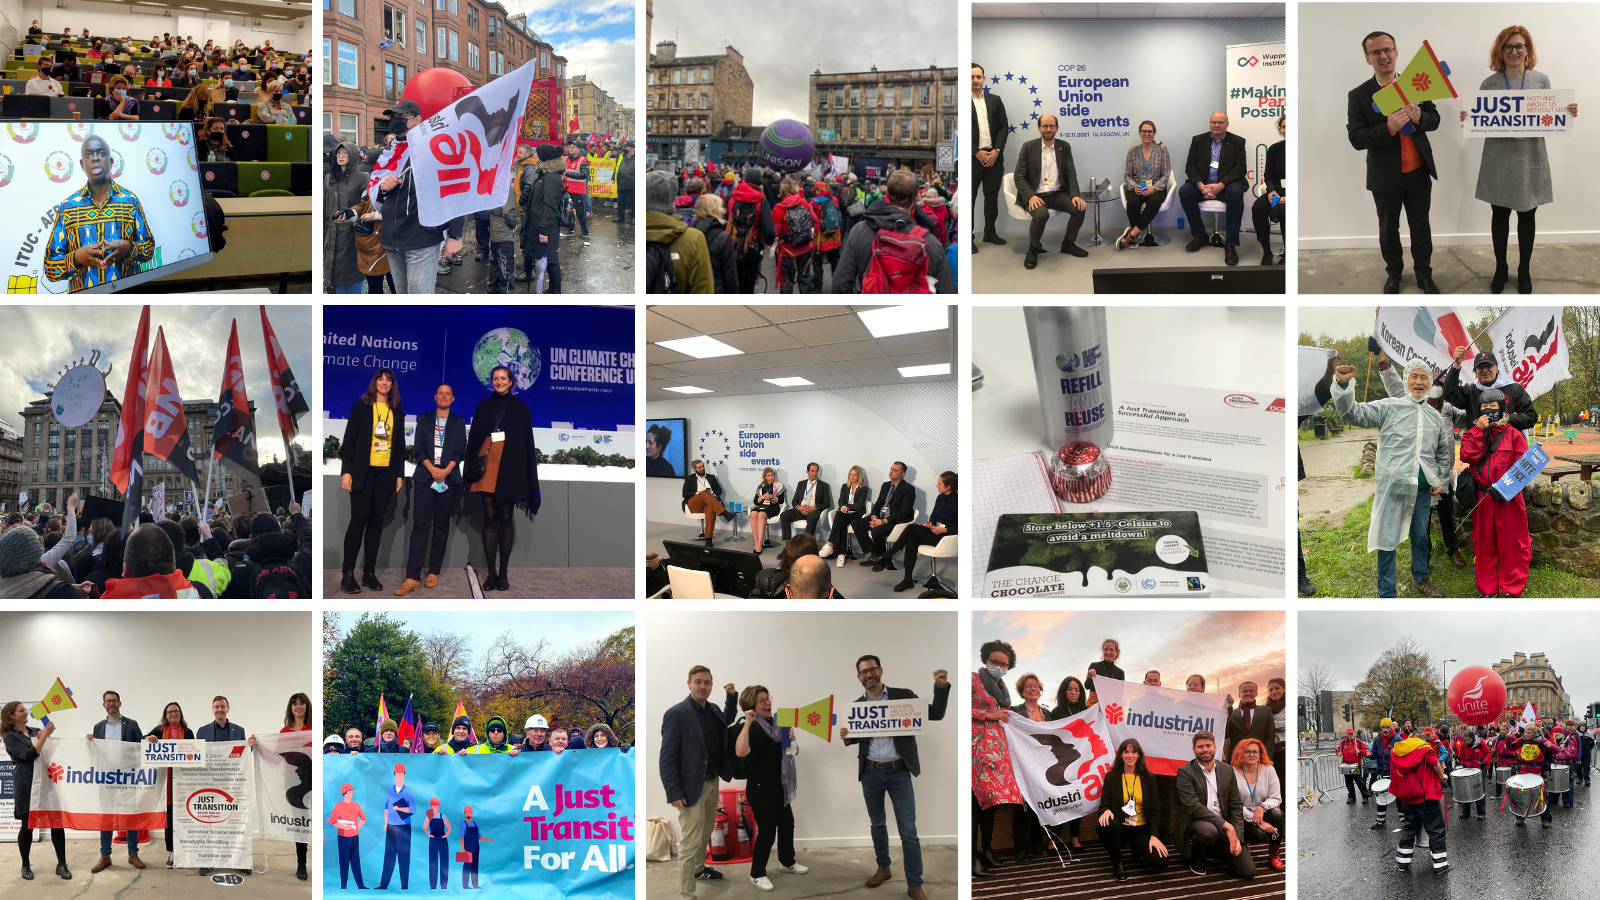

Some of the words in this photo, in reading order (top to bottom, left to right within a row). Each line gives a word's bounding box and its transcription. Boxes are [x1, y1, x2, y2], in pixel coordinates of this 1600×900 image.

[1058, 76, 1129, 90] European
[1059, 90, 1102, 102] Union
[1060, 104, 1089, 116] side
[1471, 96, 1524, 113] JUST
[1081, 116, 1130, 127] events
[762, 150, 802, 168] UNISON
[15, 233, 39, 267] ITUC
[362, 335, 418, 351] Nations
[1381, 322, 1406, 357] Korean
[364, 355, 417, 373] Change
[550, 347, 567, 363] UN
[569, 349, 617, 366] CLIMATE
[550, 364, 623, 384] CONFERENCE
[1060, 370, 1102, 394] REFILL
[1071, 390, 1099, 411] AND
[1065, 402, 1105, 426] REUSE
[1117, 410, 1153, 418] Successful
[1155, 415, 1189, 423] Approach
[1142, 408, 1176, 416] Transition
[739, 431, 780, 441] European
[739, 440, 764, 448] Union
[1120, 446, 1163, 456] Recommendations
[740, 449, 756, 457] side
[1050, 532, 1078, 541] avoid
[1090, 530, 1147, 540] meltdown!
[992, 579, 1012, 588] THE
[1016, 575, 1060, 586] CHANGE
[991, 583, 1065, 598] CHOCOLATE
[848, 705, 888, 720] JUST
[1127, 708, 1214, 733] industriAll
[145, 743, 177, 753] JUST
[66, 766, 157, 785] industriAll
[522, 785, 549, 811] A
[552, 784, 616, 817] Just
[524, 846, 576, 870] For
